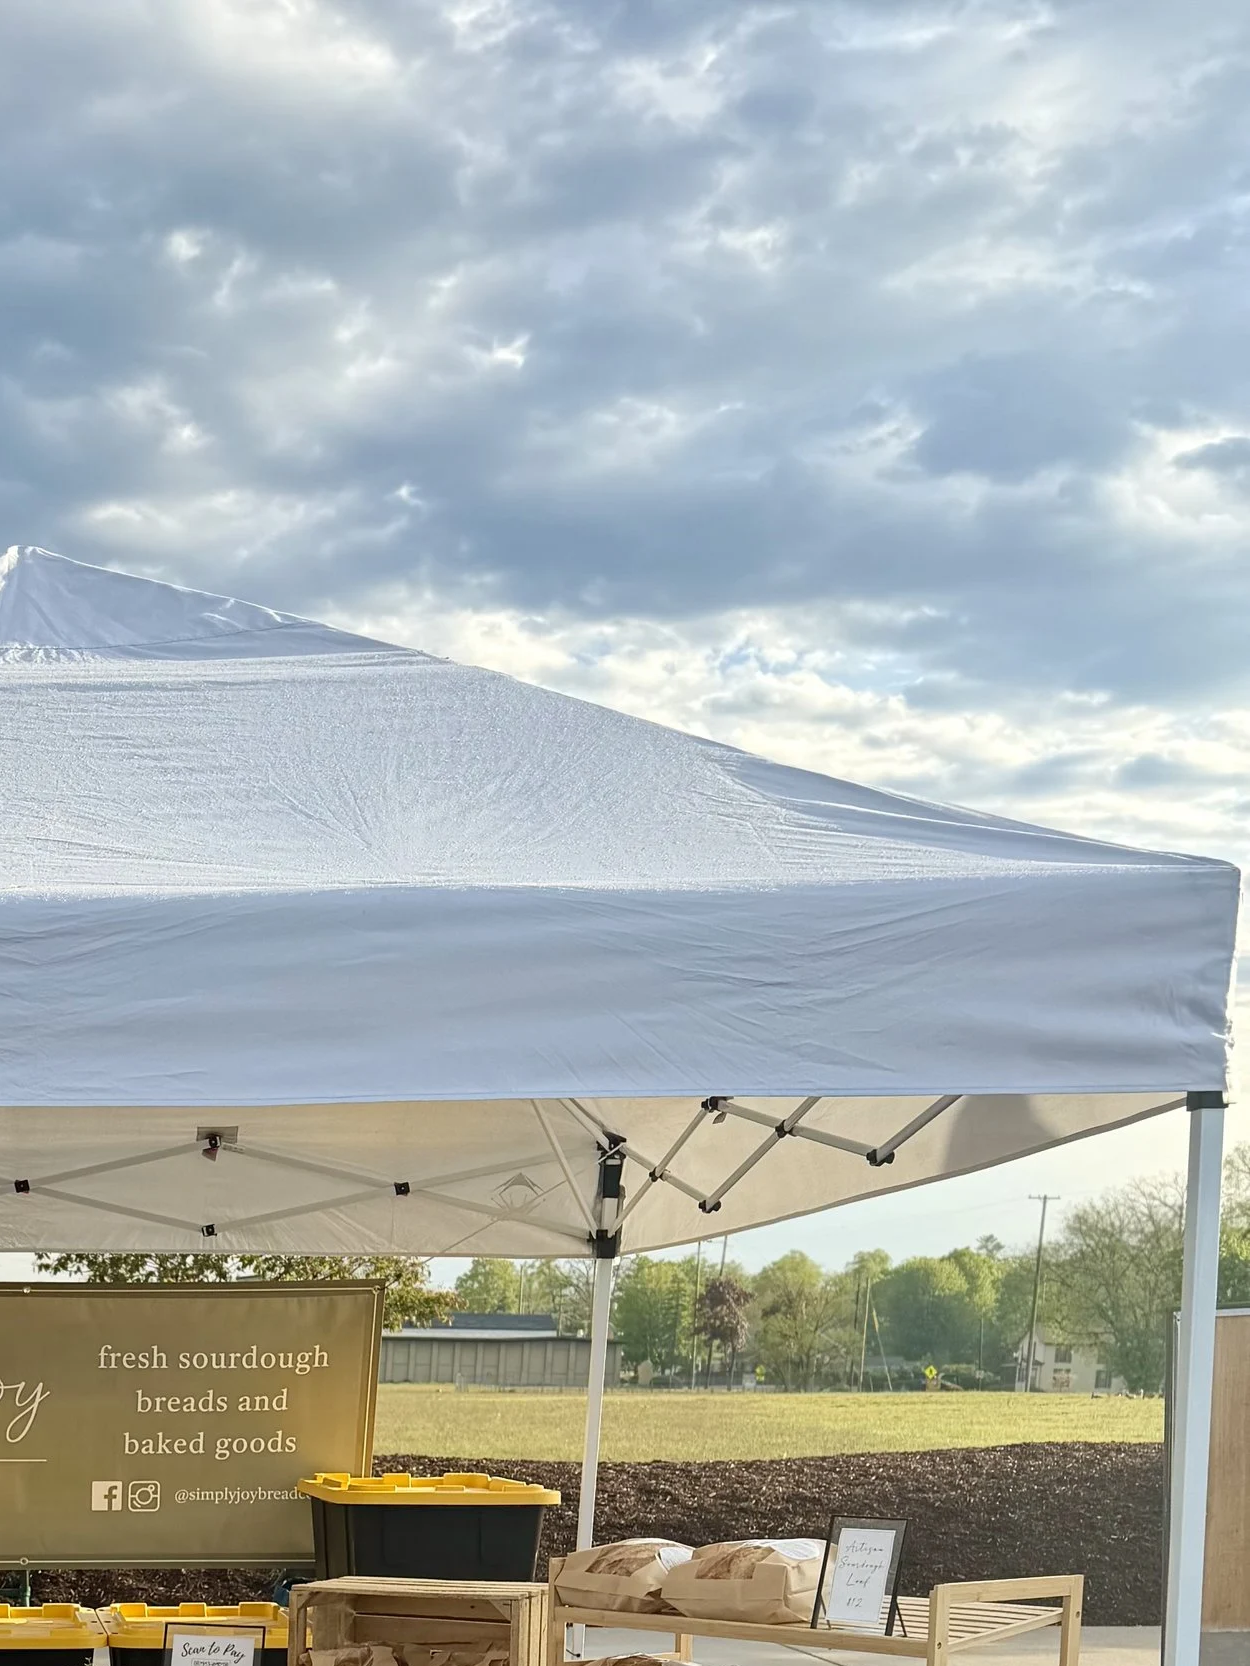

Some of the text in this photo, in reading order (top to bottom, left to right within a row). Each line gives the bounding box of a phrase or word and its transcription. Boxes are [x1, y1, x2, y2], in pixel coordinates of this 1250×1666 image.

[98, 1345, 330, 1375] fresh sourdough
[136, 1387, 289, 1413] breads and
[123, 1430, 297, 1460] baked goods
[174, 1486, 312, 1504] @simplyjoybreadc
[845, 1540, 884, 1555] Artisan
[839, 1556, 885, 1574] Sourdough
[846, 1573, 871, 1588] Loaf
[181, 1641, 246, 1664] Scan to Pay
